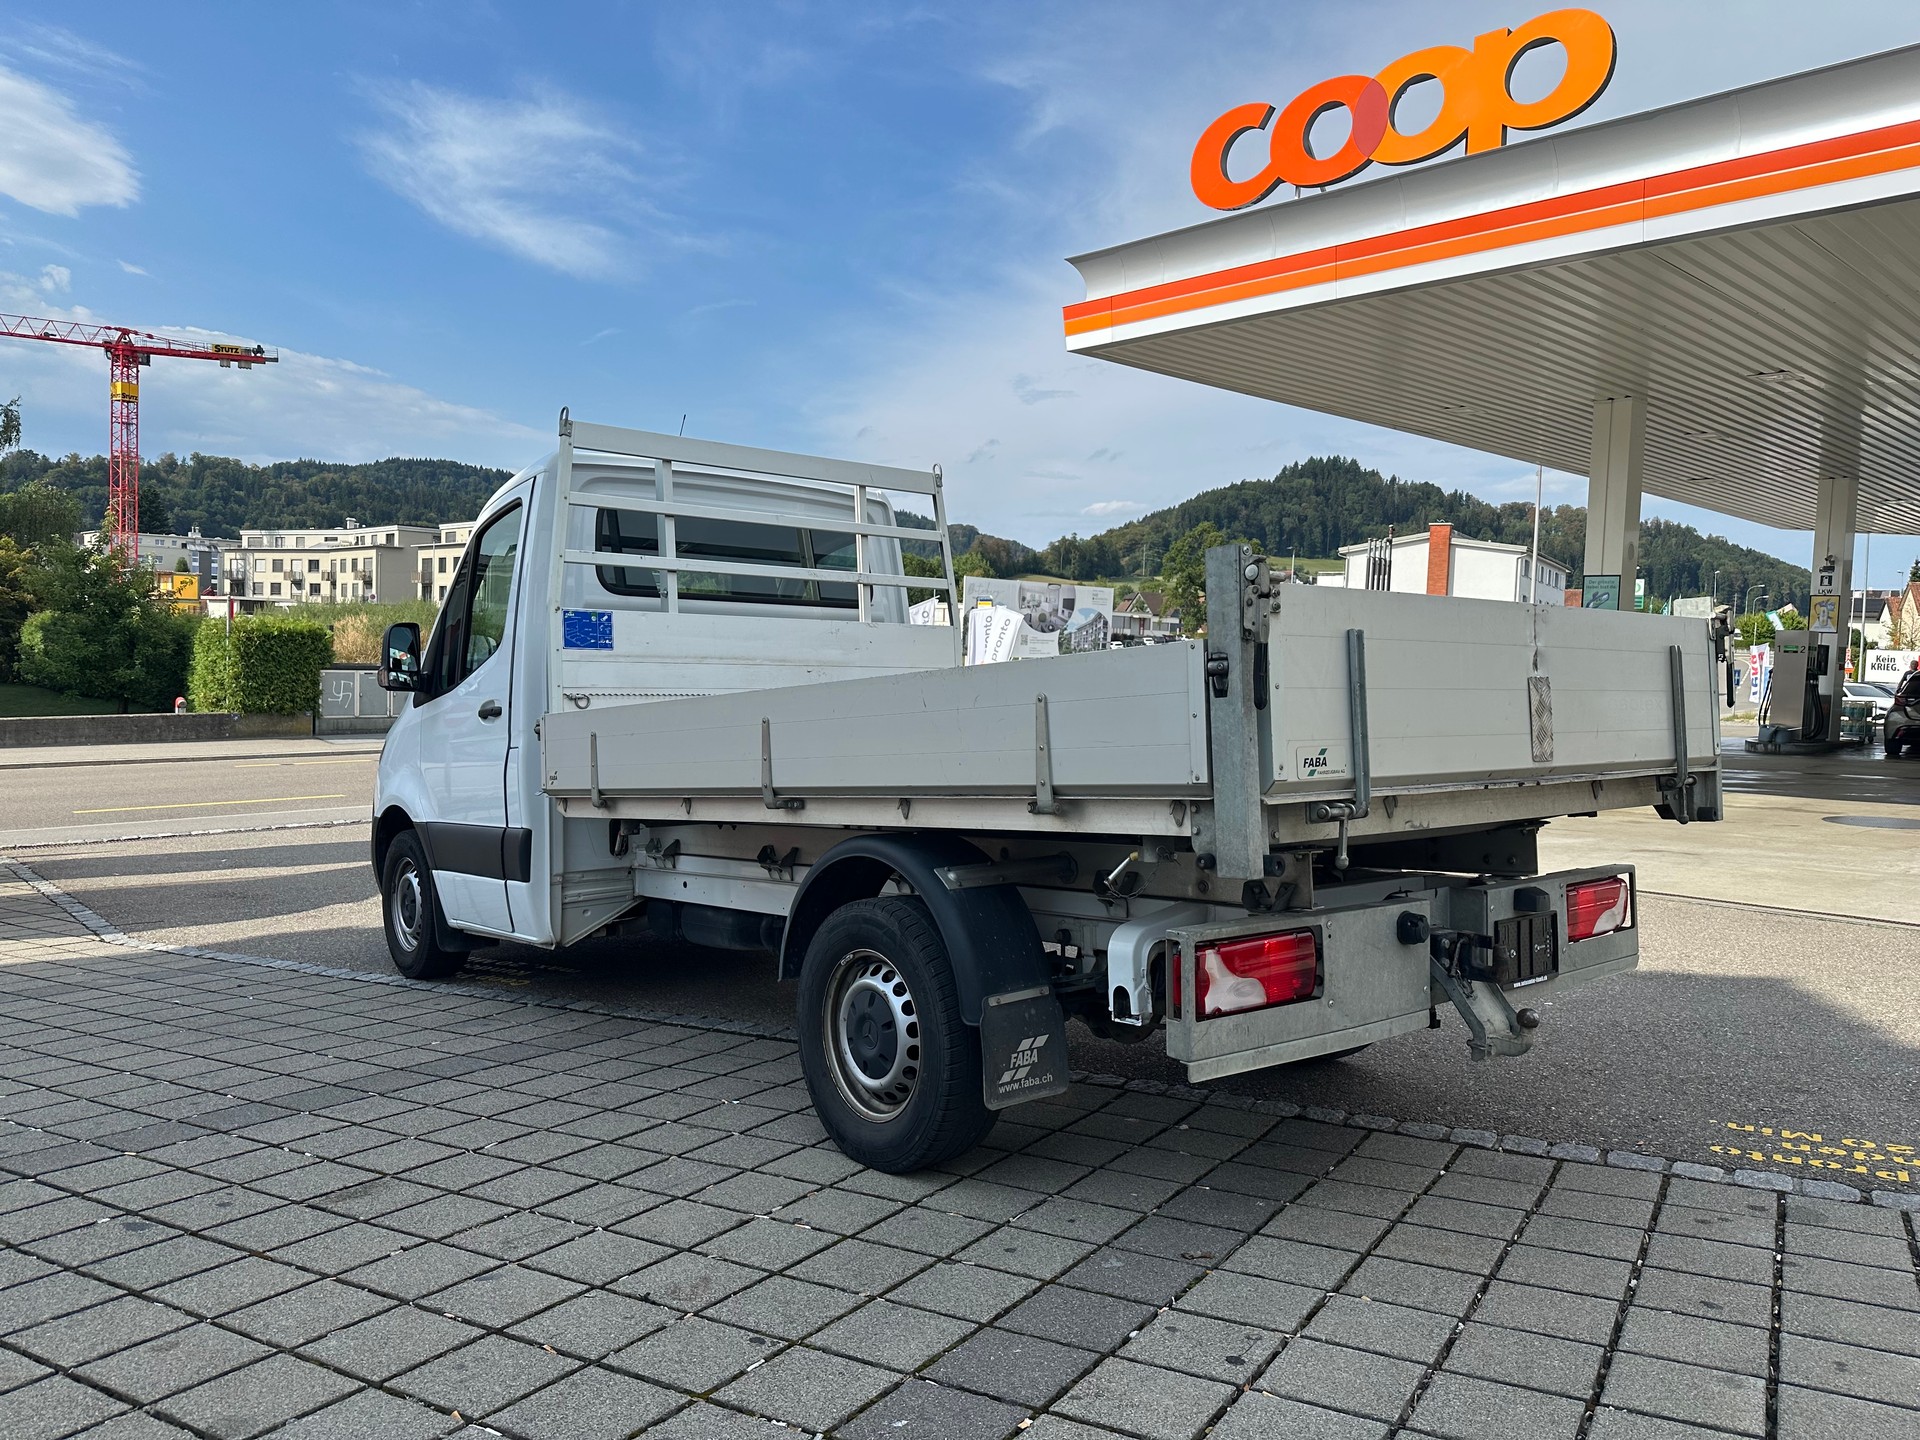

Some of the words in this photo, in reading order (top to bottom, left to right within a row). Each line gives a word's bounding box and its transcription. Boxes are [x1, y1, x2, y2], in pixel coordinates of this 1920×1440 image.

[1190, 7, 1618, 211] coop
[214, 344, 240, 354] STUTZ
[991, 618, 1011, 662] pronto
[1800, 645, 1806, 653] 2
[1876, 655, 1896, 663] Kein
[1871, 663, 1900, 672] KRIEG.
[1303, 757, 1327, 768] FABA
[1010, 1049, 1038, 1069] FABA
[998, 1073, 1053, 1094] www.faba.ch
